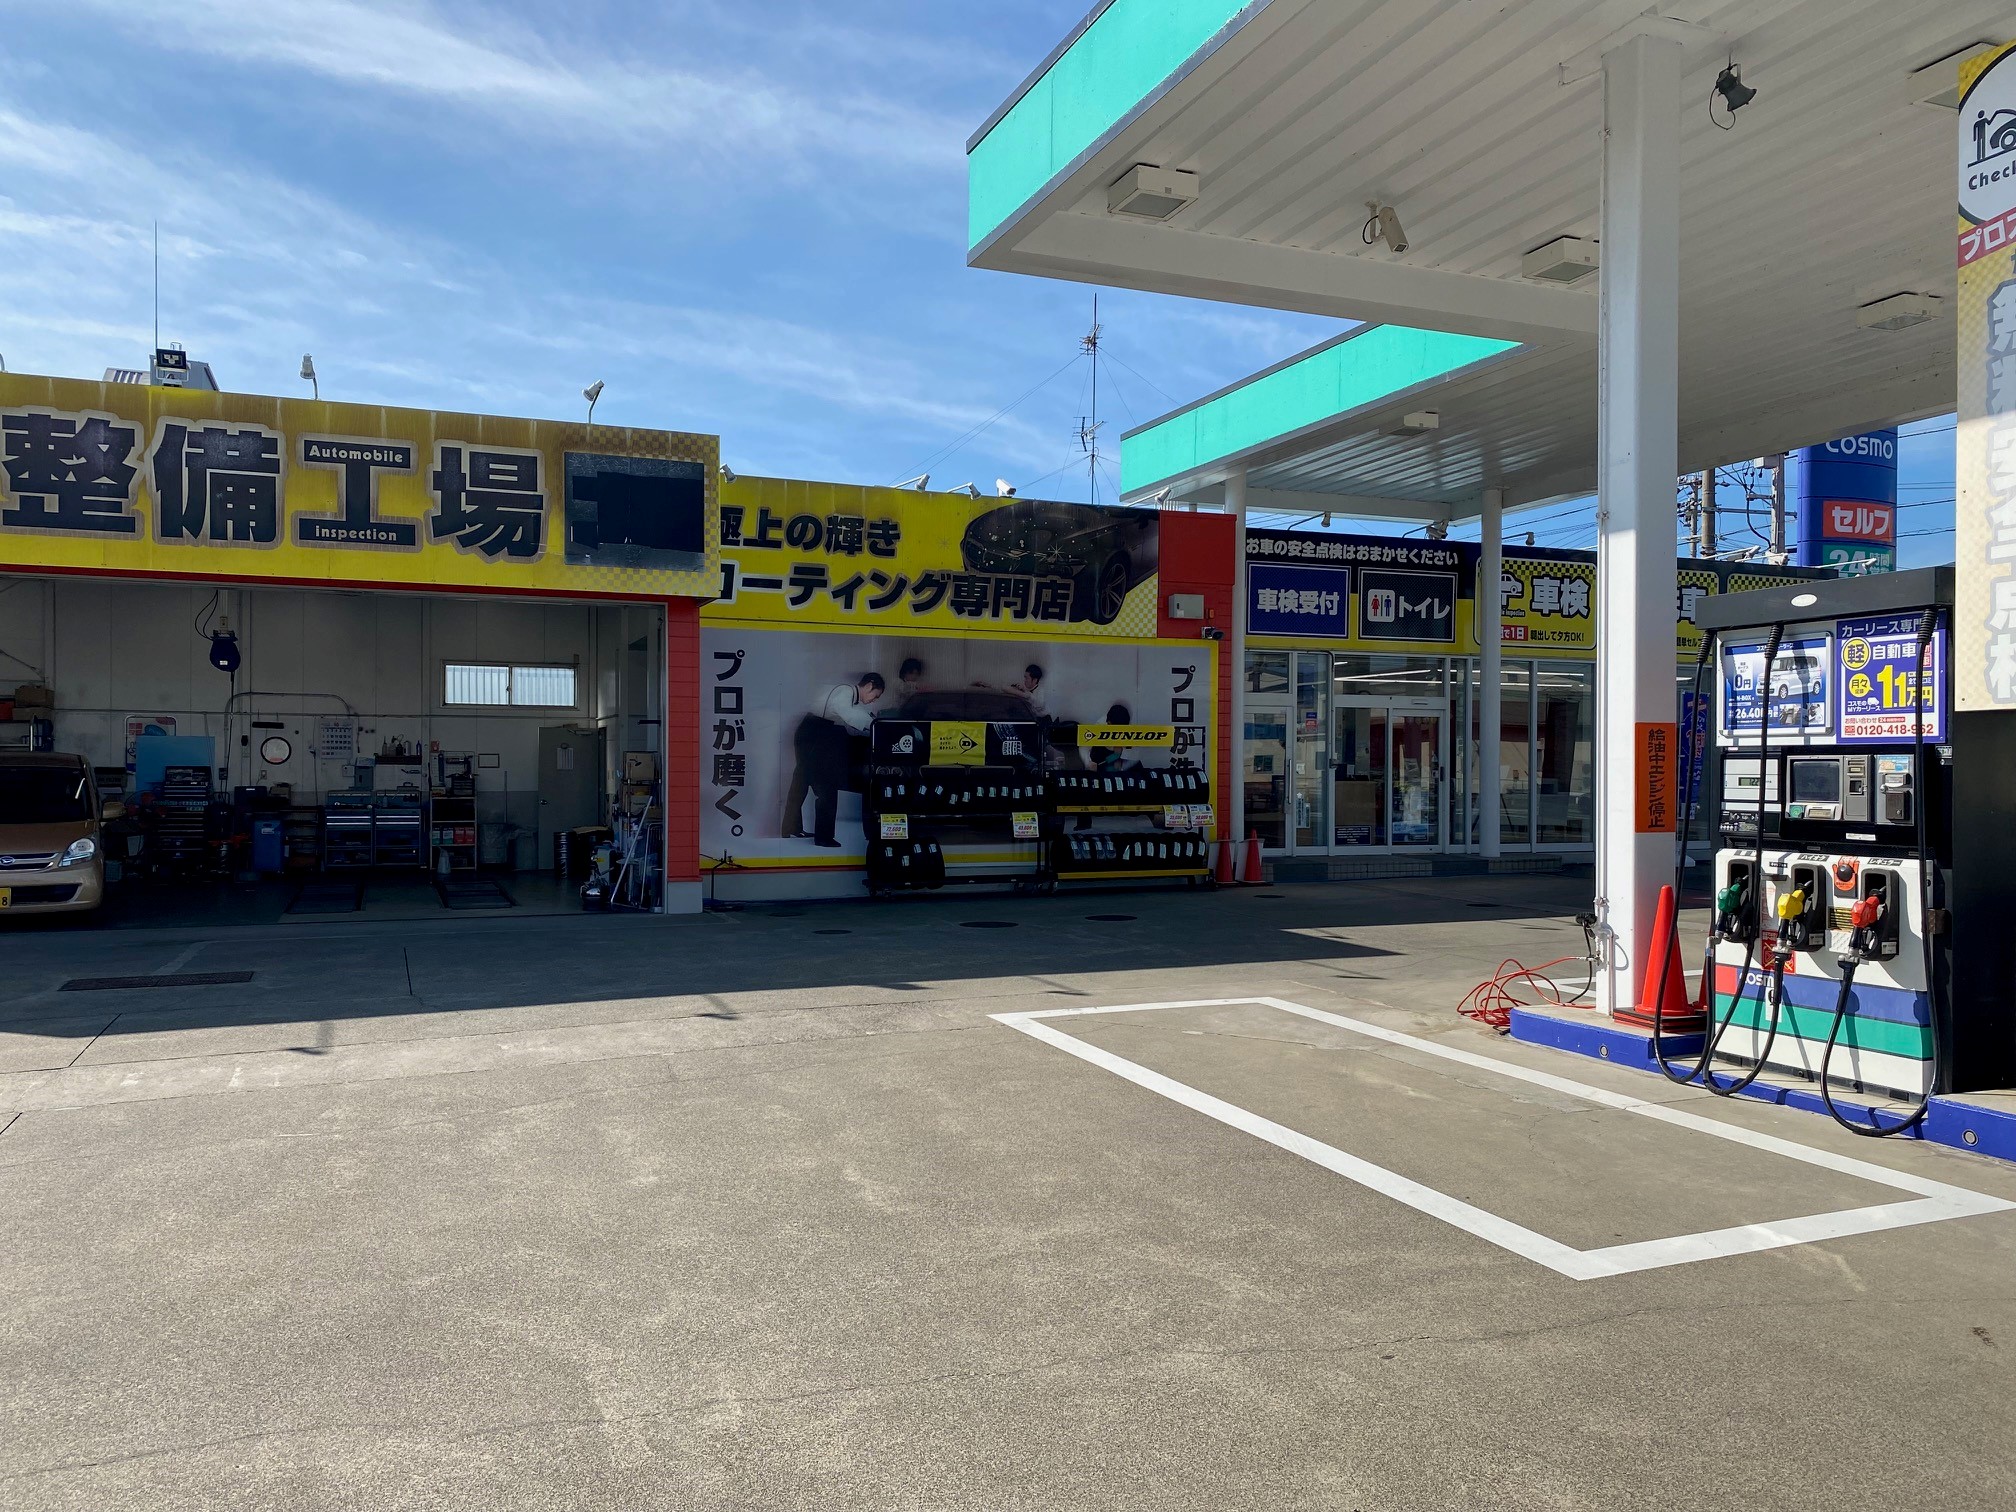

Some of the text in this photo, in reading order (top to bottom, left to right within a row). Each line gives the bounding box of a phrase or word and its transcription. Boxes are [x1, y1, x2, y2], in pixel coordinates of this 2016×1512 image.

[308, 445, 404, 463] Automobile
[2, 411, 542, 558] 整備工場
[1832, 506, 1890, 535] セルフ
[314, 526, 398, 543] inspection
[1246, 538, 1459, 567] お車の安全点検はおまかせください
[1257, 587, 1340, 616] 車検受付
[1399, 596, 1451, 620] トイレ
[1531, 576, 1590, 618] 車検
[1842, 618, 1938, 637] カーリース専門
[1847, 643, 1865, 664] 軽
[1873, 643, 1917, 660] 自動車
[1852, 679, 1868, 689] 月々
[713, 649, 746, 838] プロが磨く。
[1098, 731, 1168, 742] DUNLOP
[1648, 728, 1666, 829] 給油中エンジン停止
